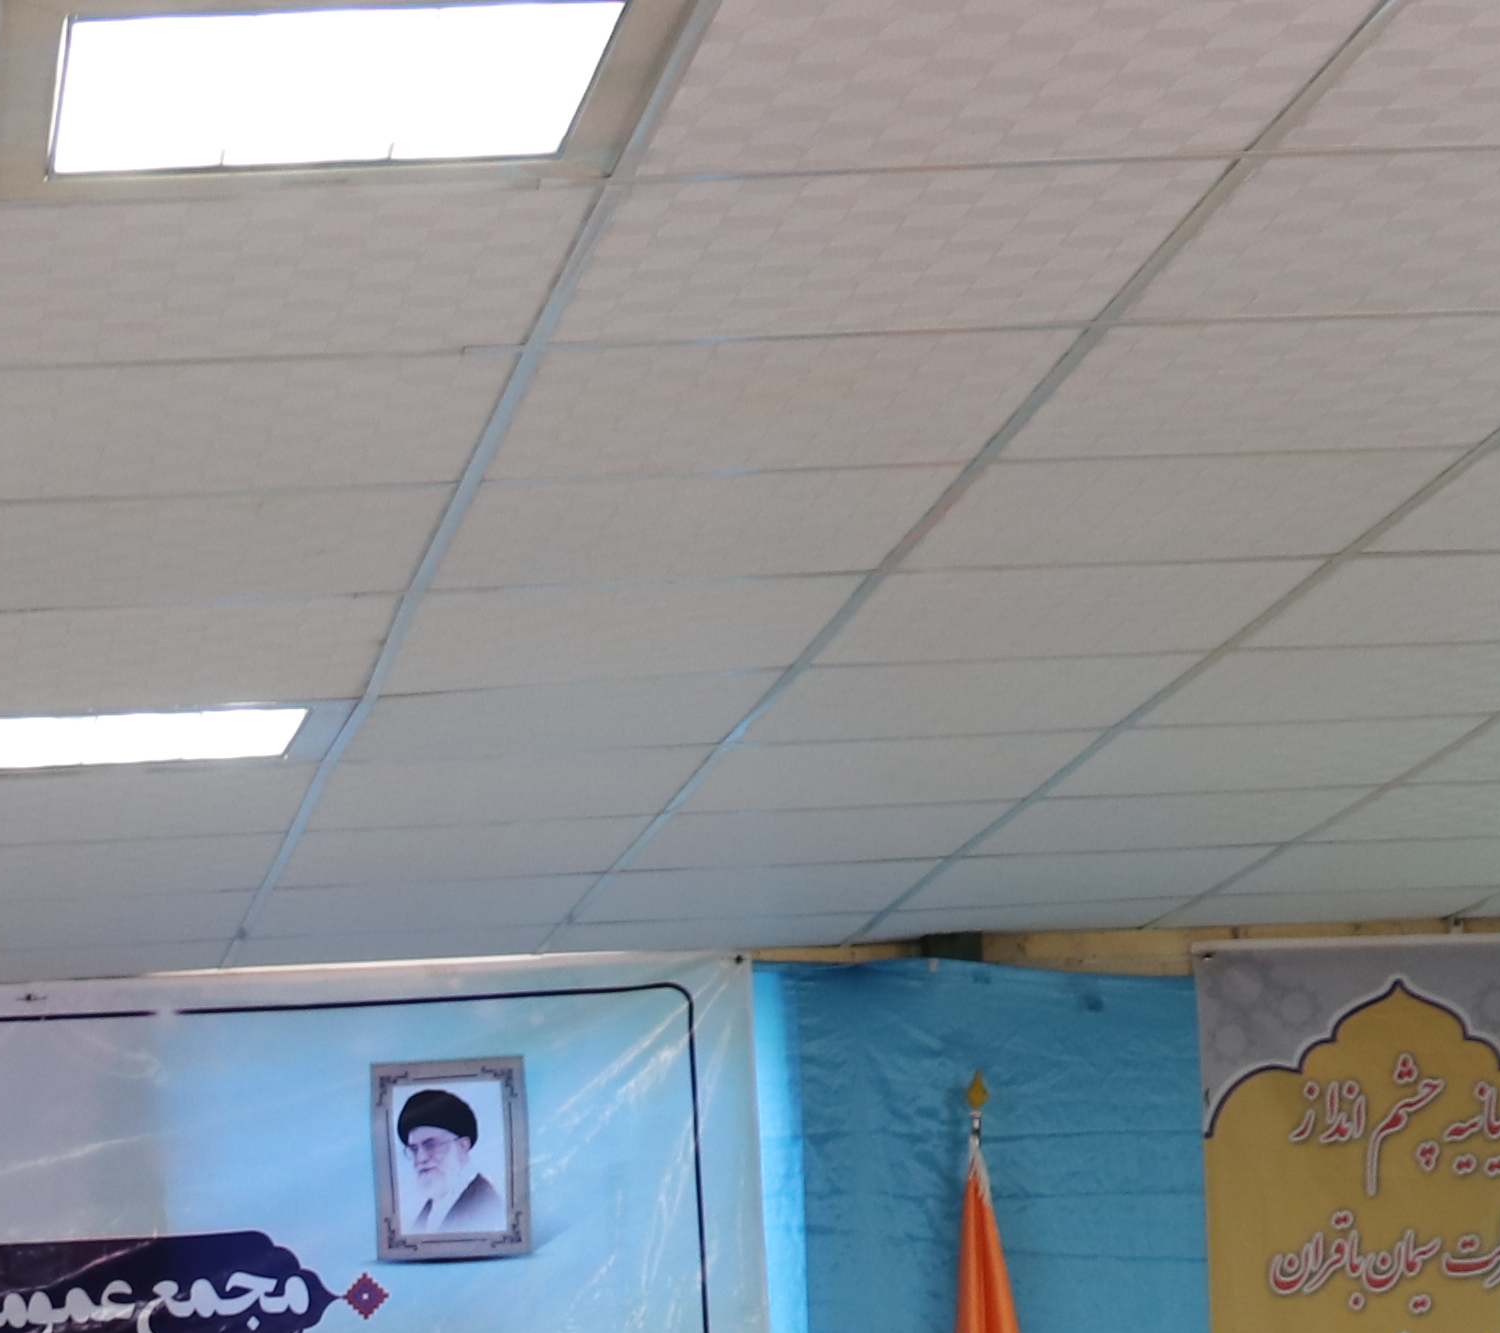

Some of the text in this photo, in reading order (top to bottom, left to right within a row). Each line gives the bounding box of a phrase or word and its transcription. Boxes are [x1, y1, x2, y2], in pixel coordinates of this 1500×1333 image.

[1289, 1081, 1367, 1143] انداز
[1365, 1053, 1445, 1198] چشم
[1268, 1211, 1363, 1311] باقران
[1363, 1229, 1441, 1312] سیمان
